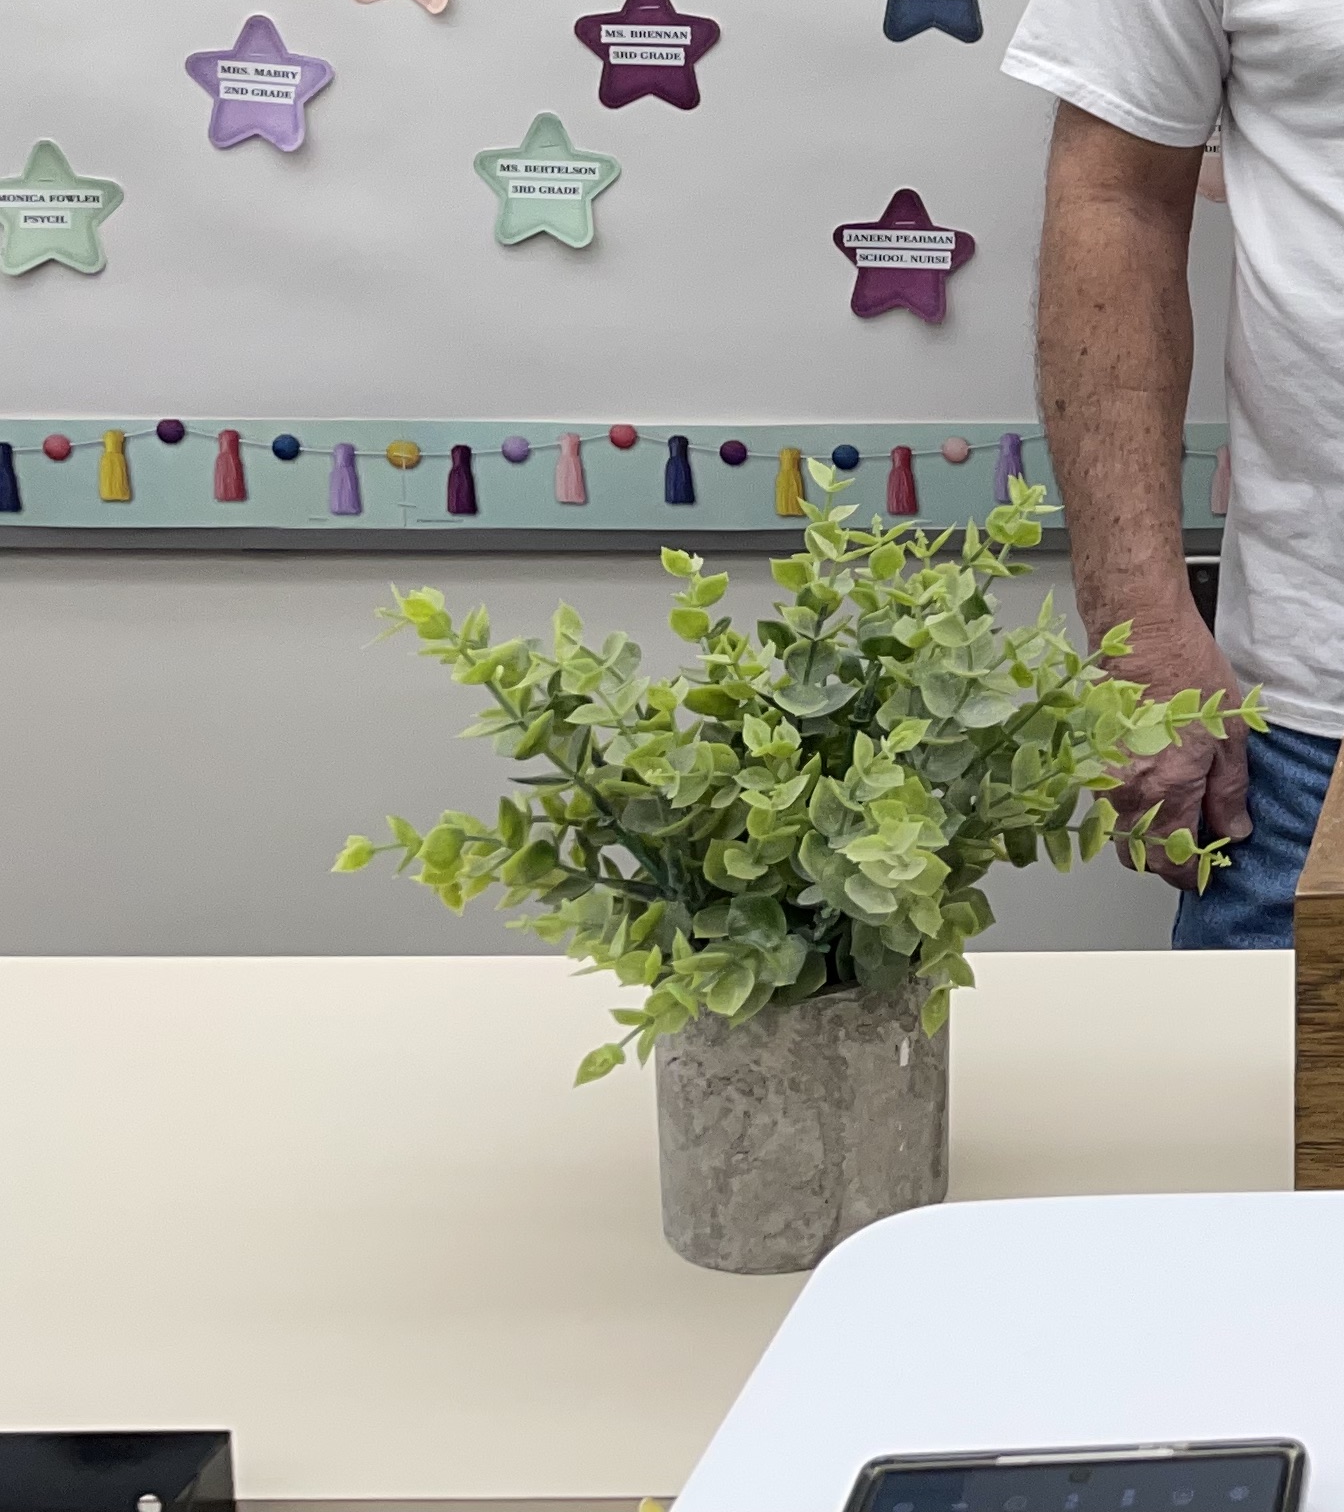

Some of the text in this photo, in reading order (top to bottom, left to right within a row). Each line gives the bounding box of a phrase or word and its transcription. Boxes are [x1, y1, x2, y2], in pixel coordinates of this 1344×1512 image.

[605, 29, 689, 40] MS. BRENNAN
[612, 50, 683, 61] 3RD GRADE
[220, 65, 299, 80] MRS. MABRY
[223, 86, 293, 100] 2ND GRADE
[499, 164, 597, 176] MS. BERTELSON
[511, 184, 581, 196] 3RD GRADE
[49, 194, 100, 203] FOWLER
[896, 234, 954, 246] PEARMAN
[858, 253, 950, 265] SCHOOL NURSE
